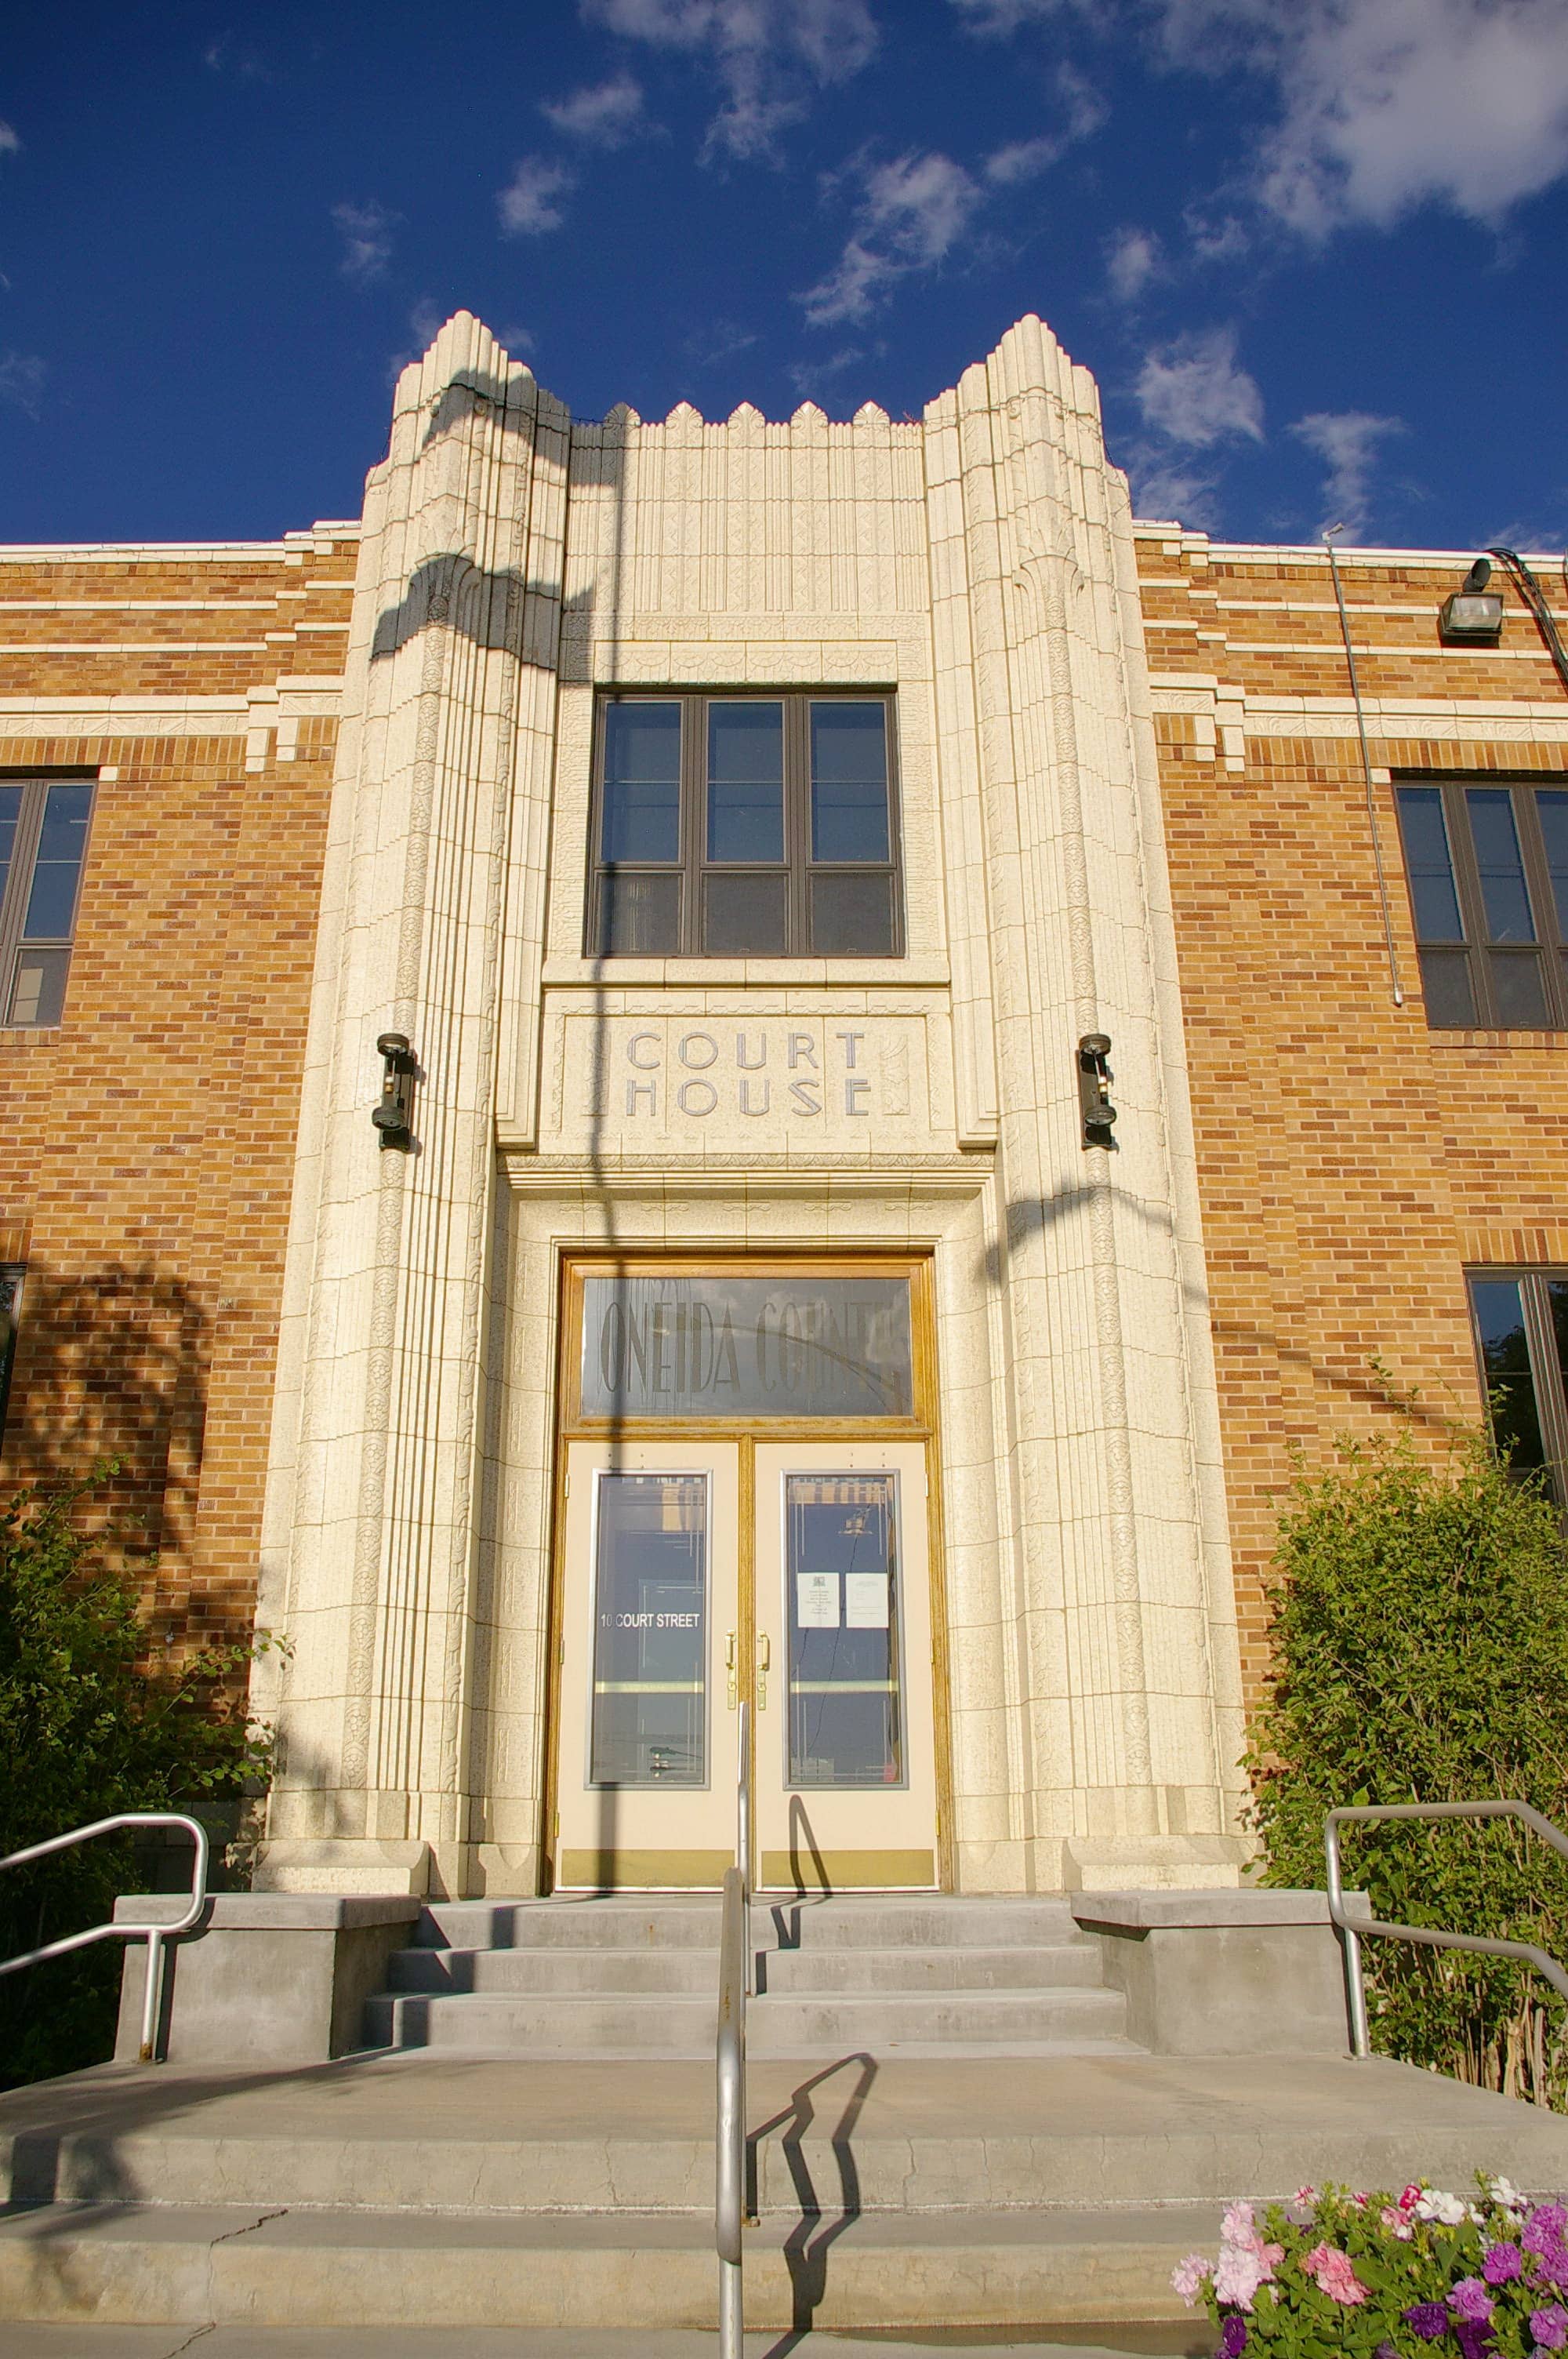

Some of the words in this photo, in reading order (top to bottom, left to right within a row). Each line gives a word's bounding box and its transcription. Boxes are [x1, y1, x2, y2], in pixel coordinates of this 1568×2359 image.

[626, 1032, 864, 1069] COURT
[626, 1079, 872, 1116] HOUSE
[601, 1301, 740, 1393] ONEIDA
[601, 1613, 612, 1627] 10
[615, 1613, 654, 1627] COURT
[656, 1613, 700, 1627] STREET
